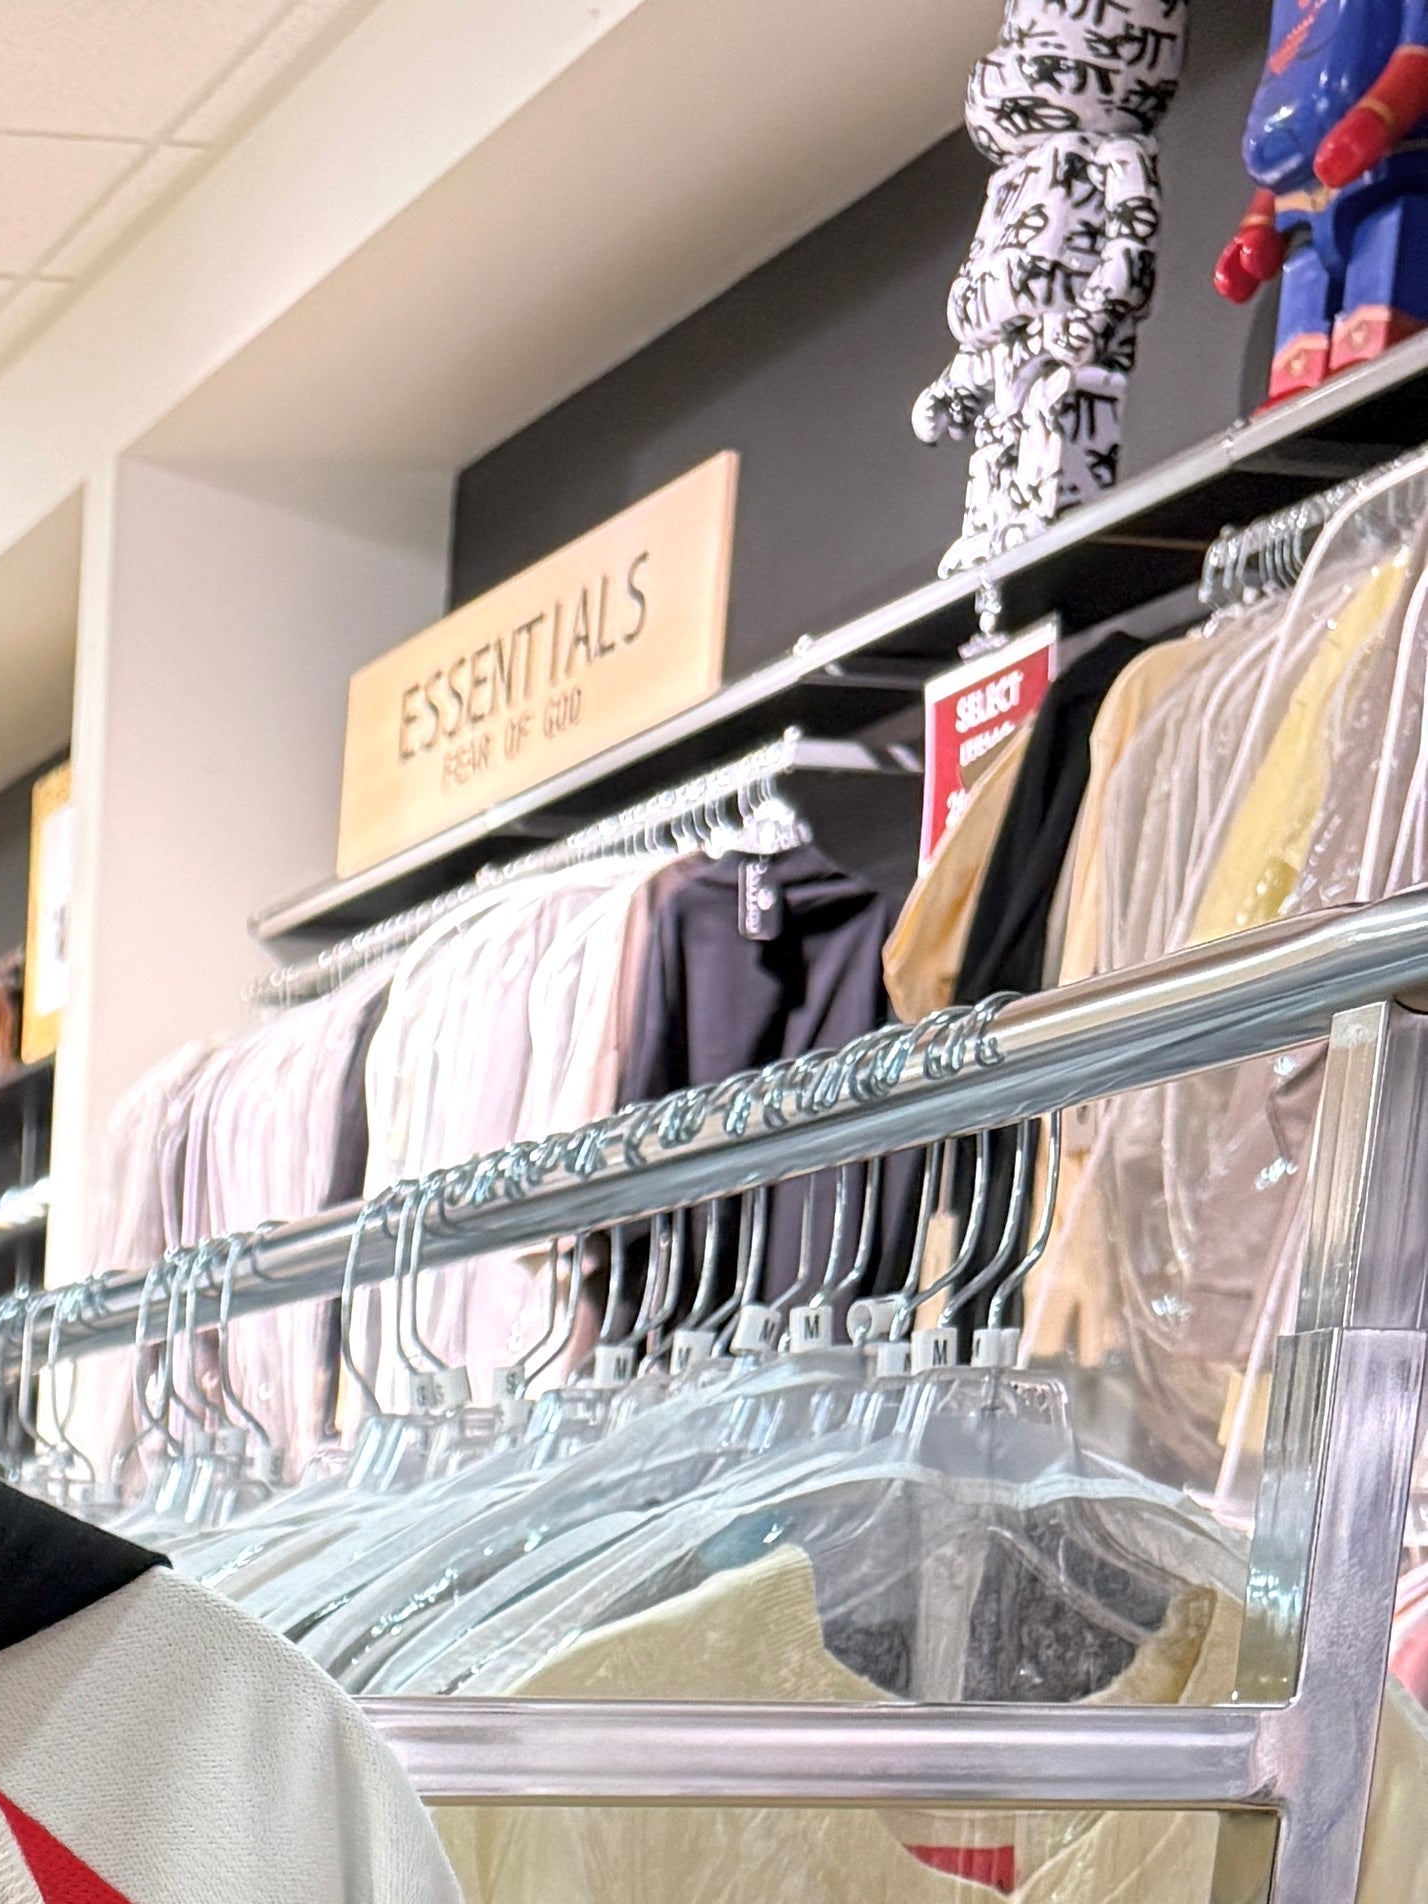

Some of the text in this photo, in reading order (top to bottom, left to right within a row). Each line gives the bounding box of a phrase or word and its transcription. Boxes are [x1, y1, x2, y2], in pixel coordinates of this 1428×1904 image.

[398, 550, 649, 764] ESSENTIALS
[805, 1316, 820, 1341] M
[933, 1338, 948, 1366] M
